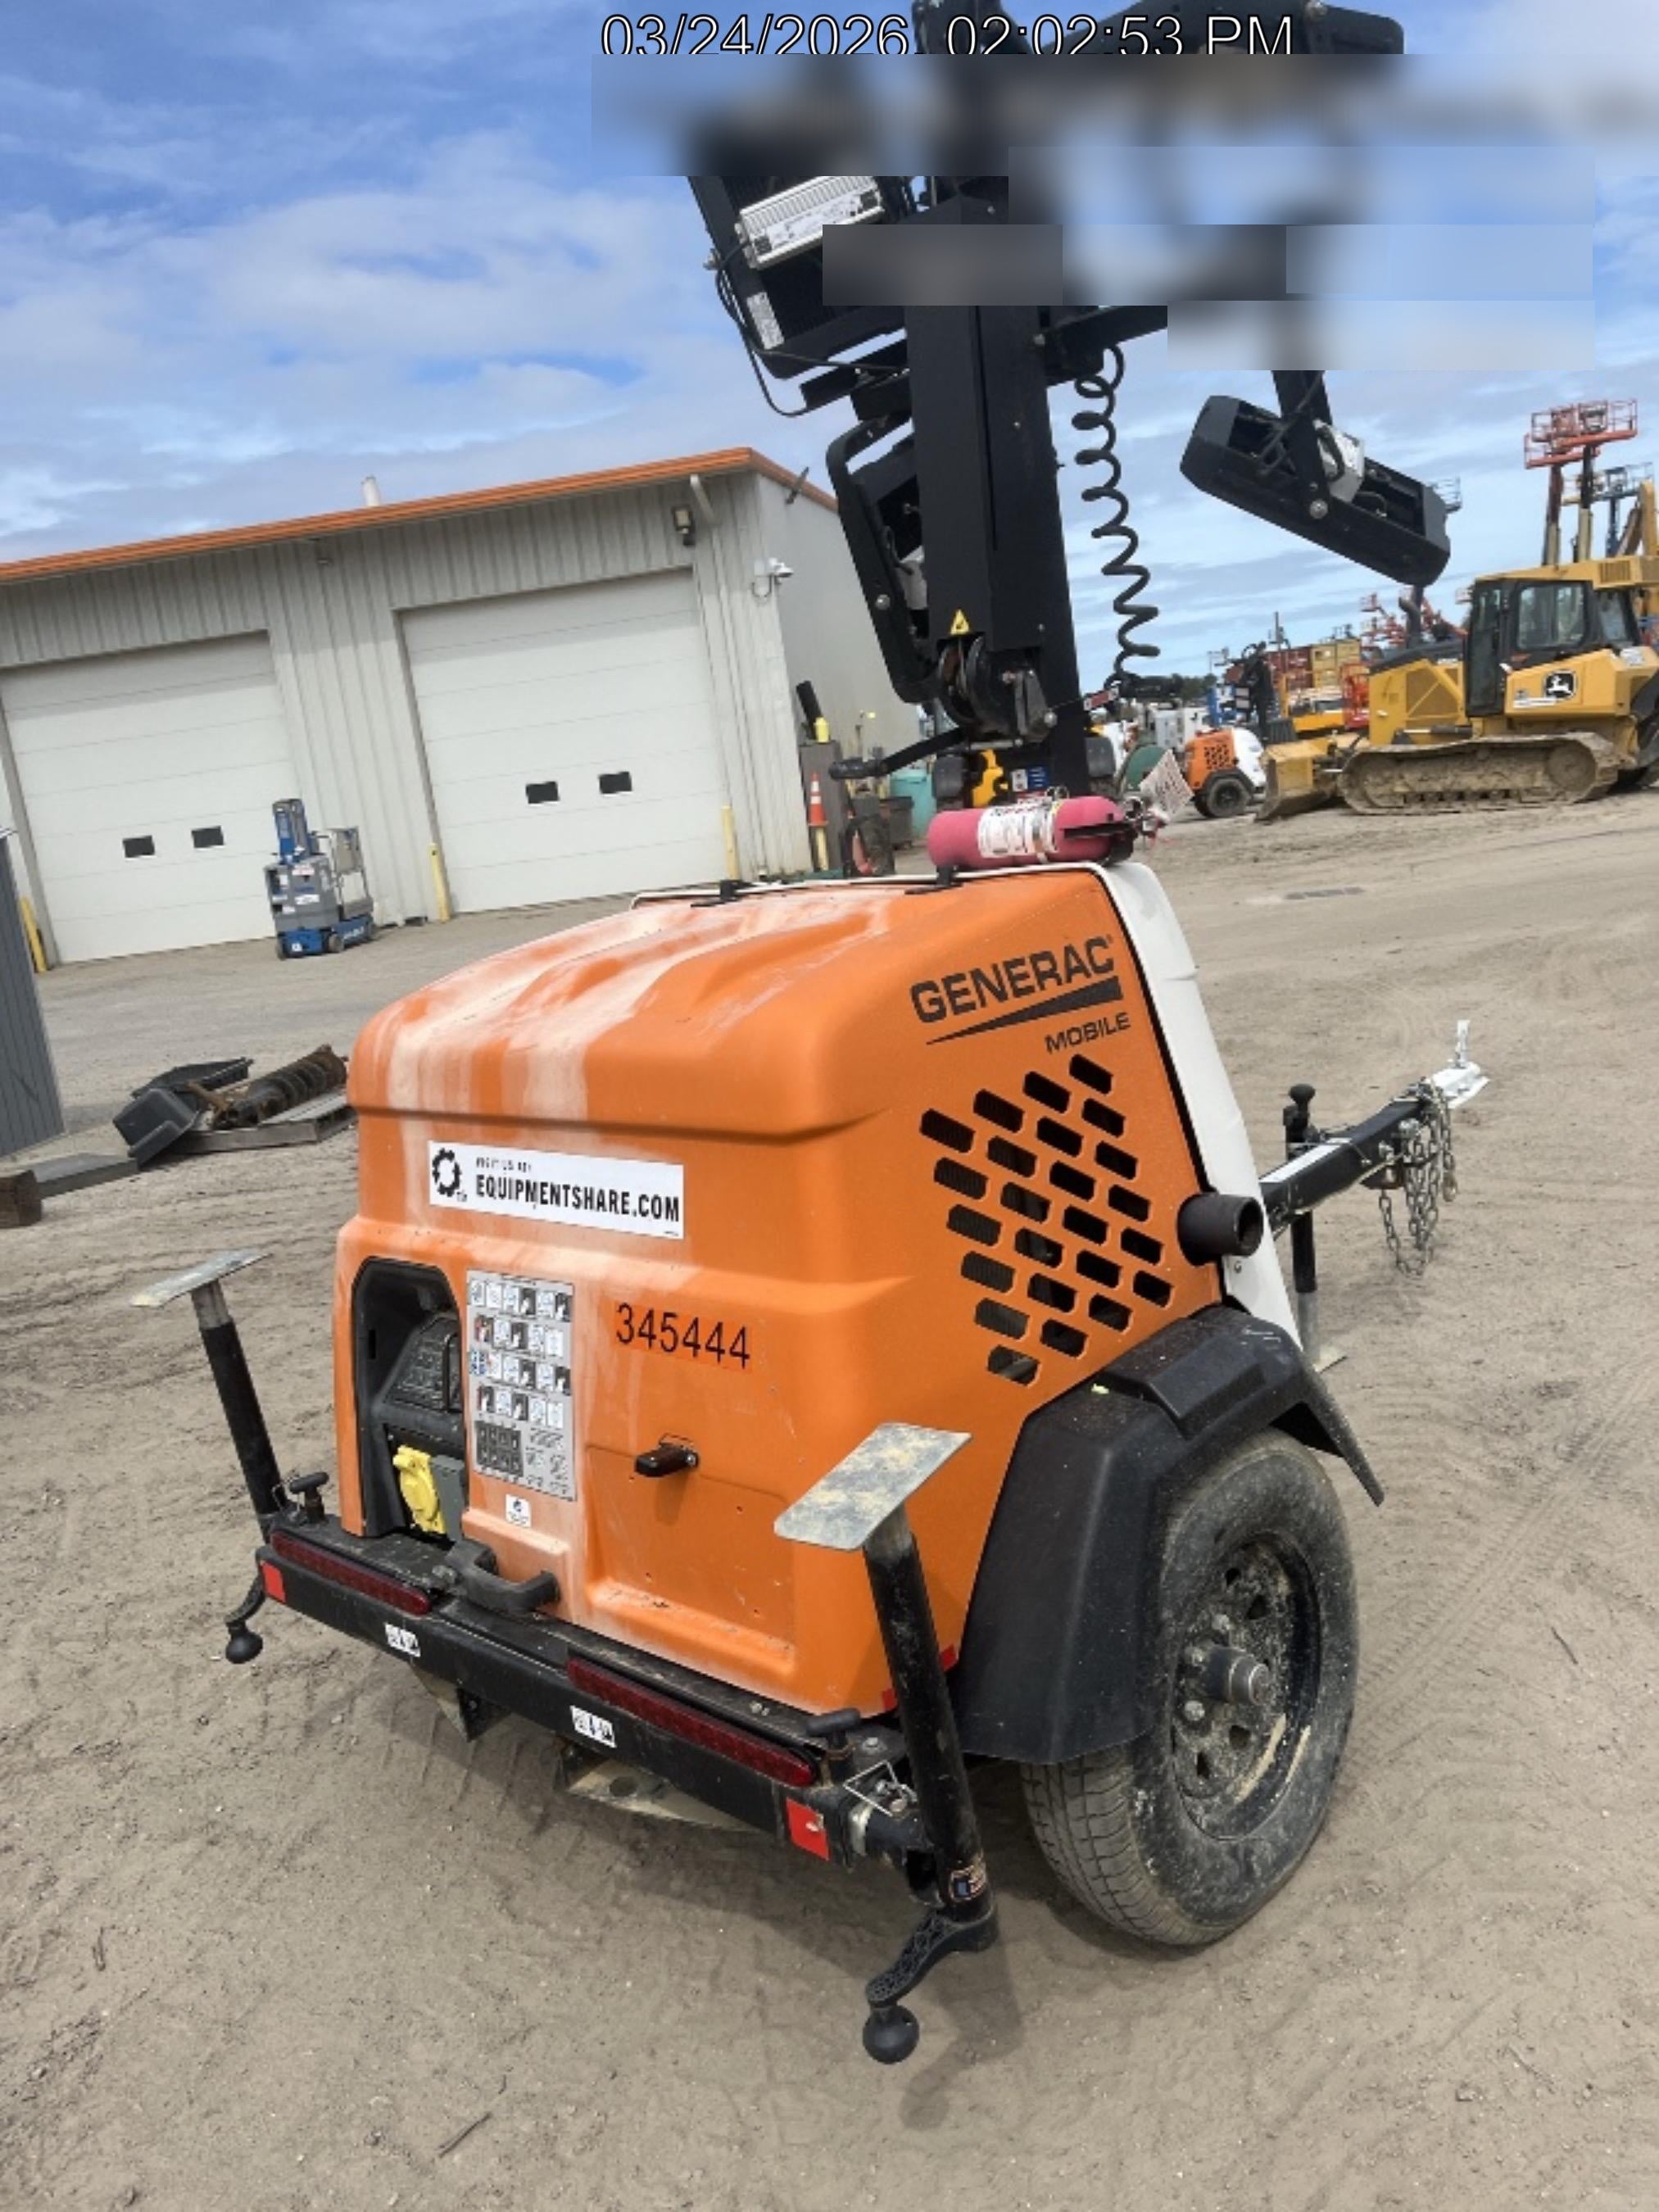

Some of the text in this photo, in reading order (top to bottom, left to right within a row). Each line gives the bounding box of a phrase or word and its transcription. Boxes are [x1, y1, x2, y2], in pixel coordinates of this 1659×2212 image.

[910, 936, 1114, 1022] GENERAC
[1045, 1012, 1131, 1054] MOBILE
[476, 1173, 679, 1222] EQUIPMENTSHARE.COM
[616, 1302, 750, 1370] 345444
